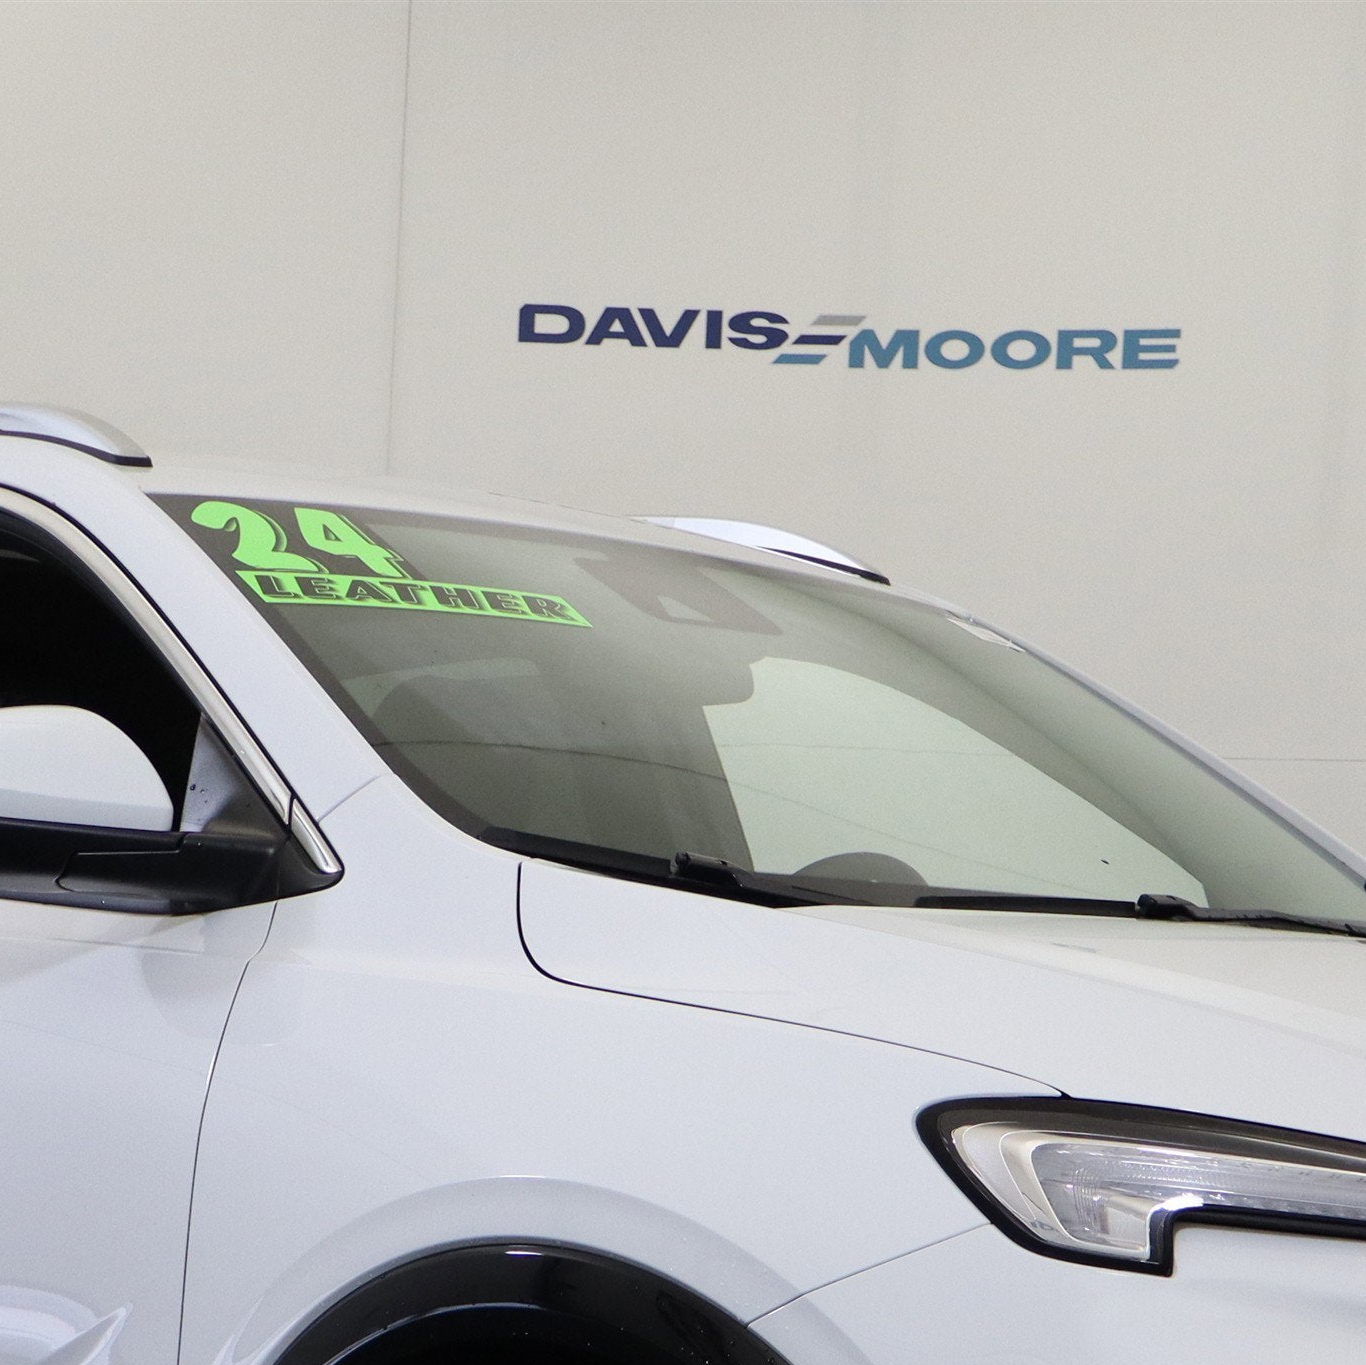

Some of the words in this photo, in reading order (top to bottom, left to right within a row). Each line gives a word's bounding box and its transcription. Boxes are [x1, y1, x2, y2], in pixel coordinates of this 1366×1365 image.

[517, 302, 790, 350] DAVIS
[848, 328, 1183, 370] MOORE
[190, 500, 411, 579] 24
[254, 574, 575, 621] LEATHER
